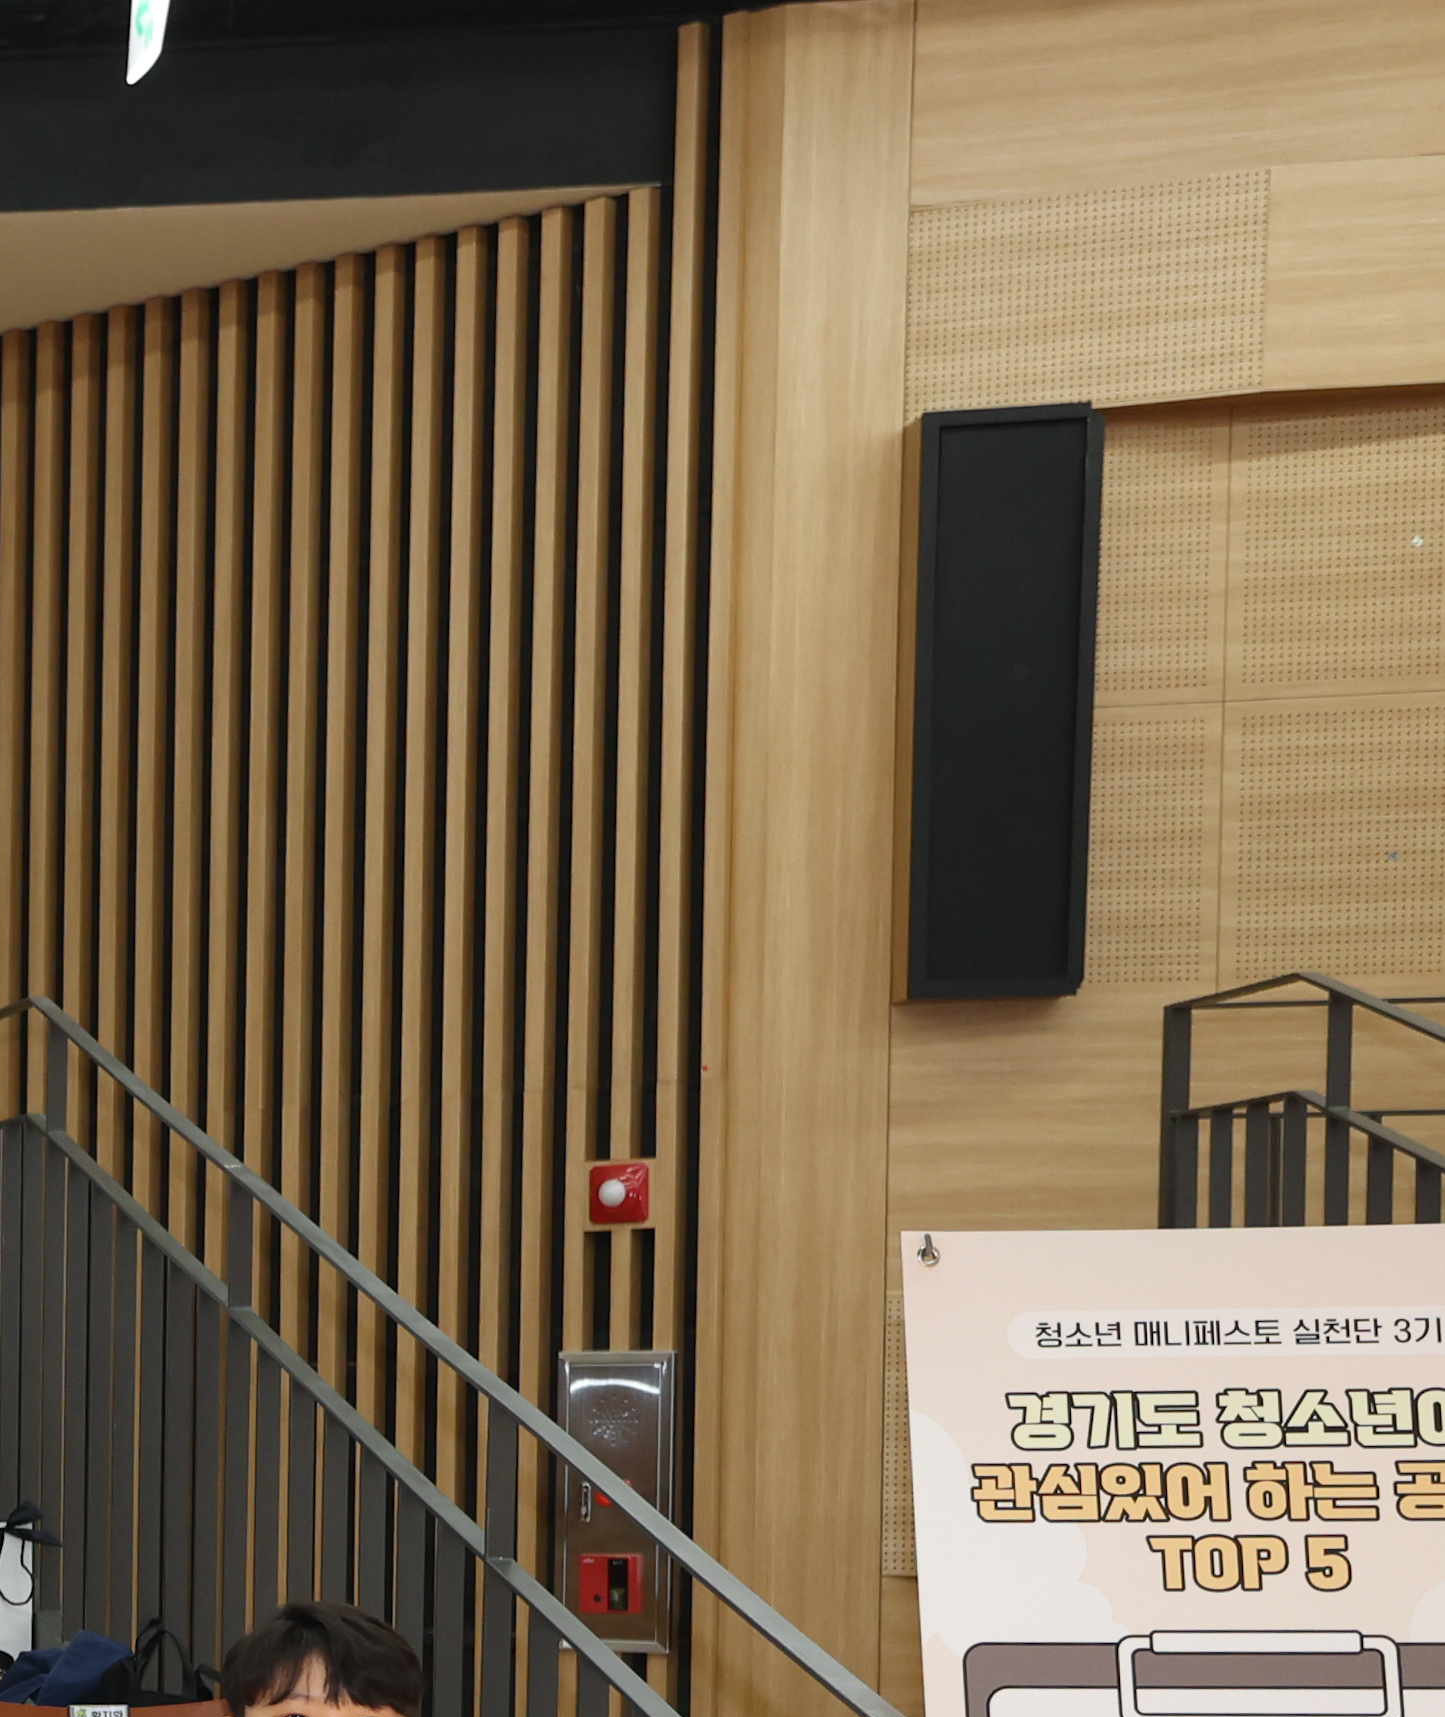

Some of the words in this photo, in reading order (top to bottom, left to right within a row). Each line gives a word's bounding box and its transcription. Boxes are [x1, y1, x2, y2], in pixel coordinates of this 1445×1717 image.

[1035, 1320, 1122, 1348] 청소년
[1133, 1319, 1282, 1347] 매니페스토
[1292, 1317, 1382, 1346] 실천단
[1392, 1317, 1442, 1345] 3기
[1005, 1390, 1204, 1451] 경기도
[970, 1461, 1232, 1523] 관심있어
[1242, 1460, 1380, 1522] 하는
[1393, 1459, 1445, 1521] 공
[1145, 1533, 1290, 1593] TOP
[1304, 1534, 1352, 1593] 5
